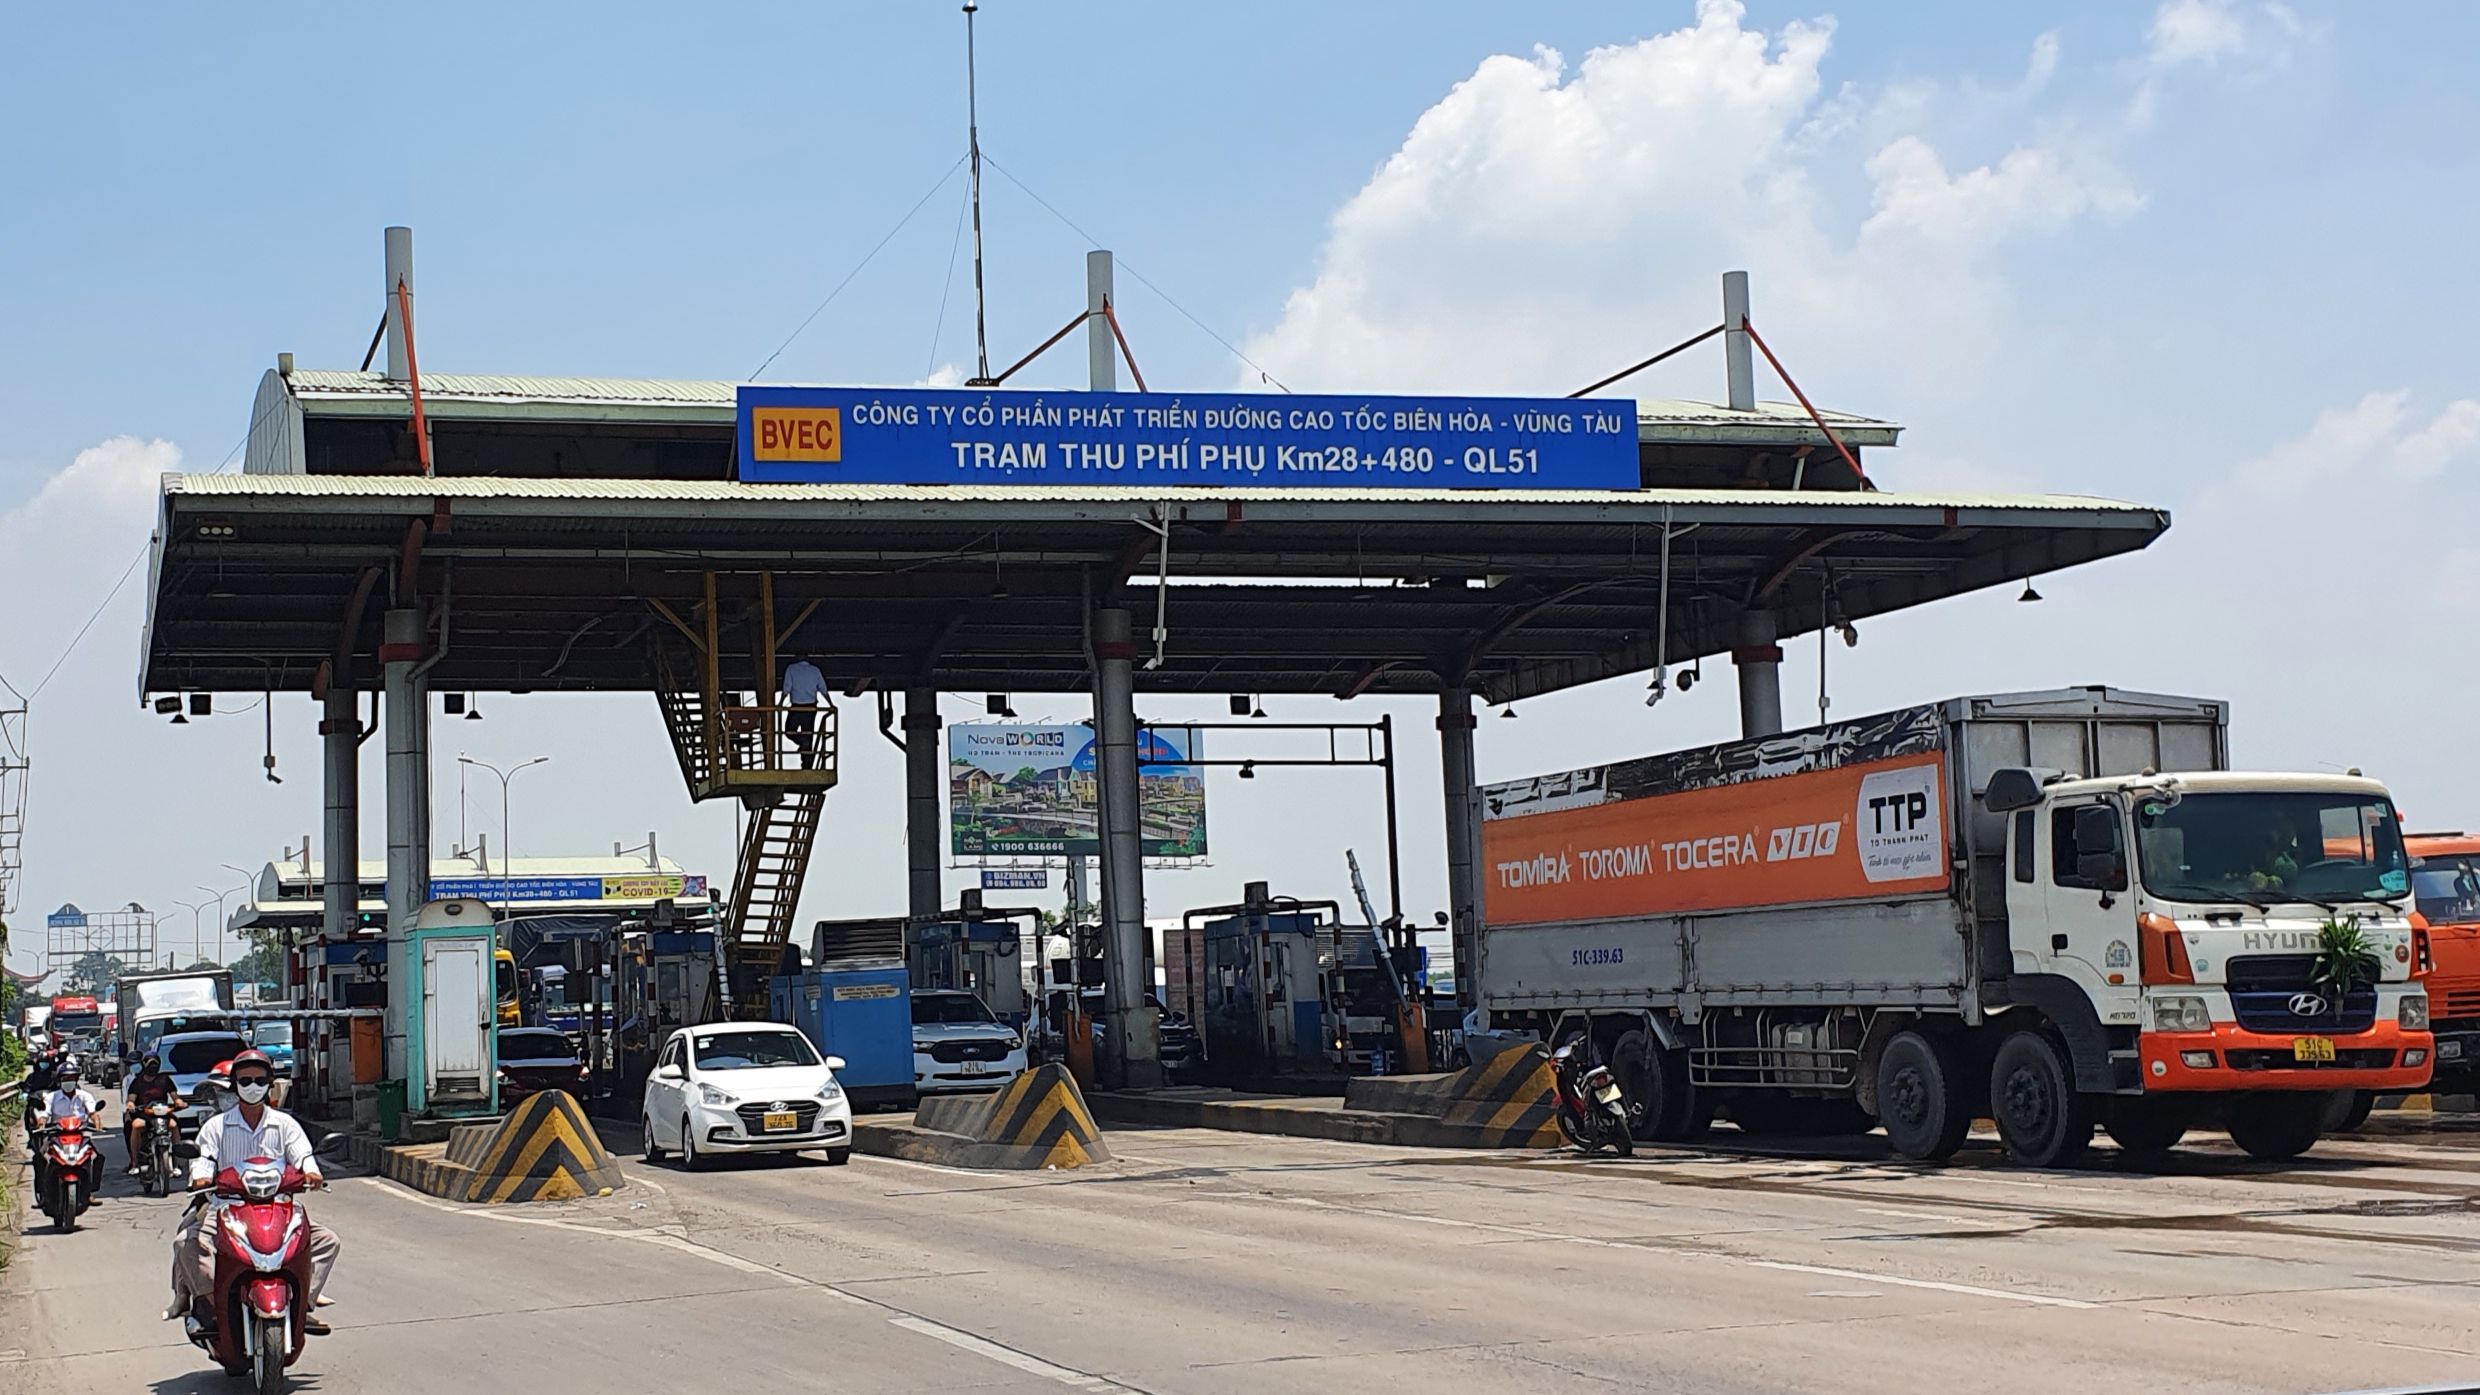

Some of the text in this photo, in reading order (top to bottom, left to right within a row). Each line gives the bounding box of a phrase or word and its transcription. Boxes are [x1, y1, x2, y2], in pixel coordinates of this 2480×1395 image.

[853, 400, 919, 425] CÔNG
[926, 406, 955, 425] TY
[962, 396, 994, 426] CỔ
[1001, 398, 1061, 427] PHẦN
[1068, 403, 1125, 428] PHÁT
[1133, 399, 1197, 428] TRIỂN
[1205, 403, 1282, 430] ĐƯỜNG
[1289, 410, 1334, 430] CAO
[1341, 404, 1387, 431] TỐC
[1394, 408, 1442, 431] BIÊN
[1449, 407, 1493, 432] HÒA
[1513, 409, 1572, 433] VŨNG
[1582, 410, 1621, 434] TÀU
[761, 419, 833, 450] BVEC
[951, 443, 1047, 475] TRẠM
[1058, 443, 1125, 470] THU
[1136, 437, 1190, 470] PHÍ
[1200, 444, 1266, 477] PHỤ
[1277, 446, 1433, 472] Km28+480
[1463, 447, 1538, 474] QL51
[1869, 791, 1927, 834] TTP
[1000, 843, 1065, 851] 1900 636666
[1579, 845, 1654, 881] TOROMA
[1662, 833, 1759, 872] TOCERA
[1572, 948, 1623, 966] 51C-339.63
